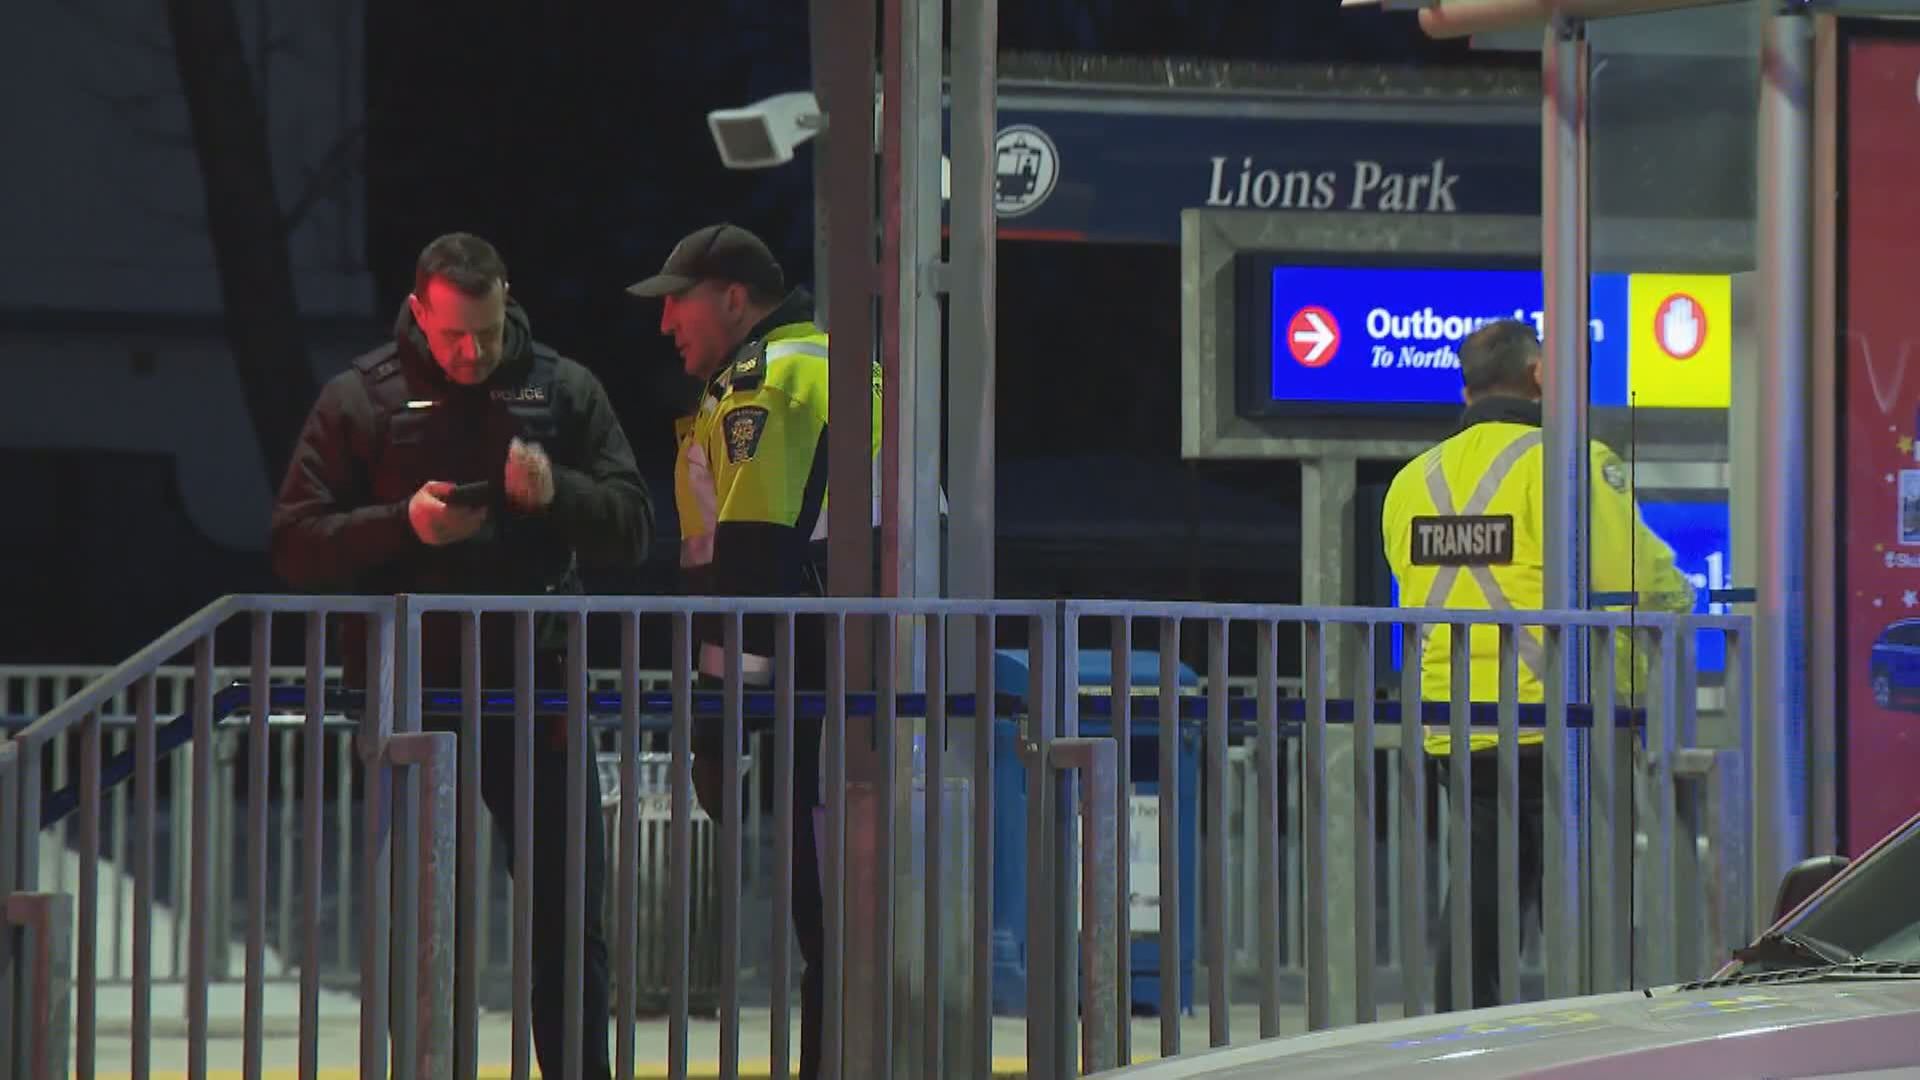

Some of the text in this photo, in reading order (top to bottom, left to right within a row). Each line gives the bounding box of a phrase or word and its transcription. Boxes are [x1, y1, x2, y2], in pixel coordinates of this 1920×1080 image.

[1206, 157, 1460, 212] Lions Park
[1366, 307, 1524, 340] Outbou
[1372, 345, 1395, 368] To
[489, 387, 545, 400] POLICE
[1418, 522, 1507, 557] TRANSIT
